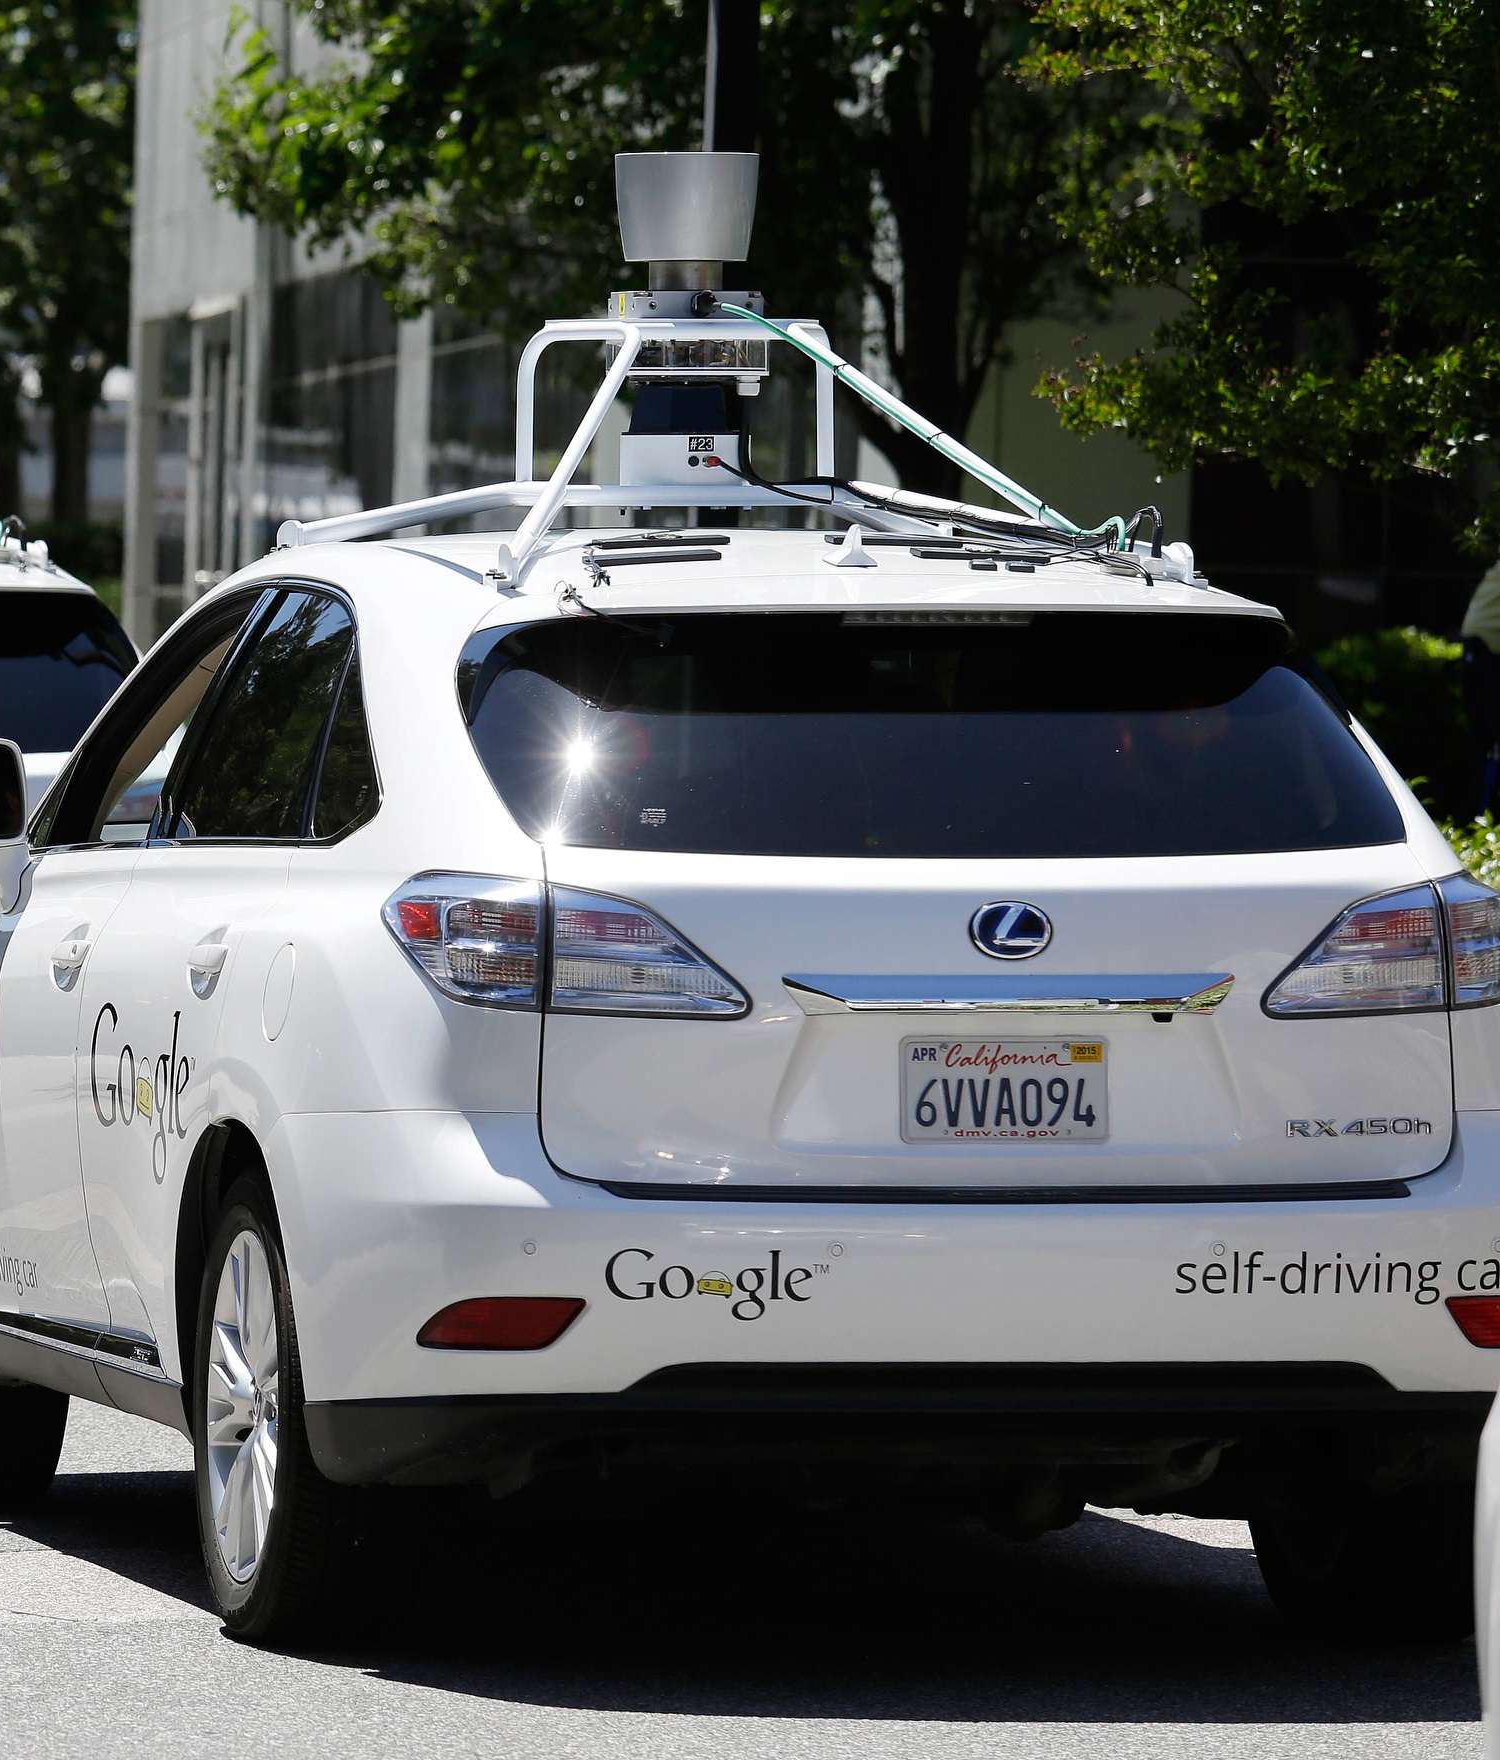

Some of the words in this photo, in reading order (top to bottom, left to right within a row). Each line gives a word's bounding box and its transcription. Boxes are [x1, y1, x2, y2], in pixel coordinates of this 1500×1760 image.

[690, 438, 714, 450] #23
[912, 1047, 937, 1062] APR
[945, 1043, 1072, 1075] California
[1076, 1046, 1097, 1055] 2015
[915, 1077, 1096, 1128] 6VVA094
[954, 1129, 1060, 1139] dmv.ca.gov
[1286, 1118, 1339, 1138] RX
[1341, 1116, 1432, 1136] 450h
[22, 1260, 39, 1289] car
[1175, 1251, 1442, 1305] self-driving
